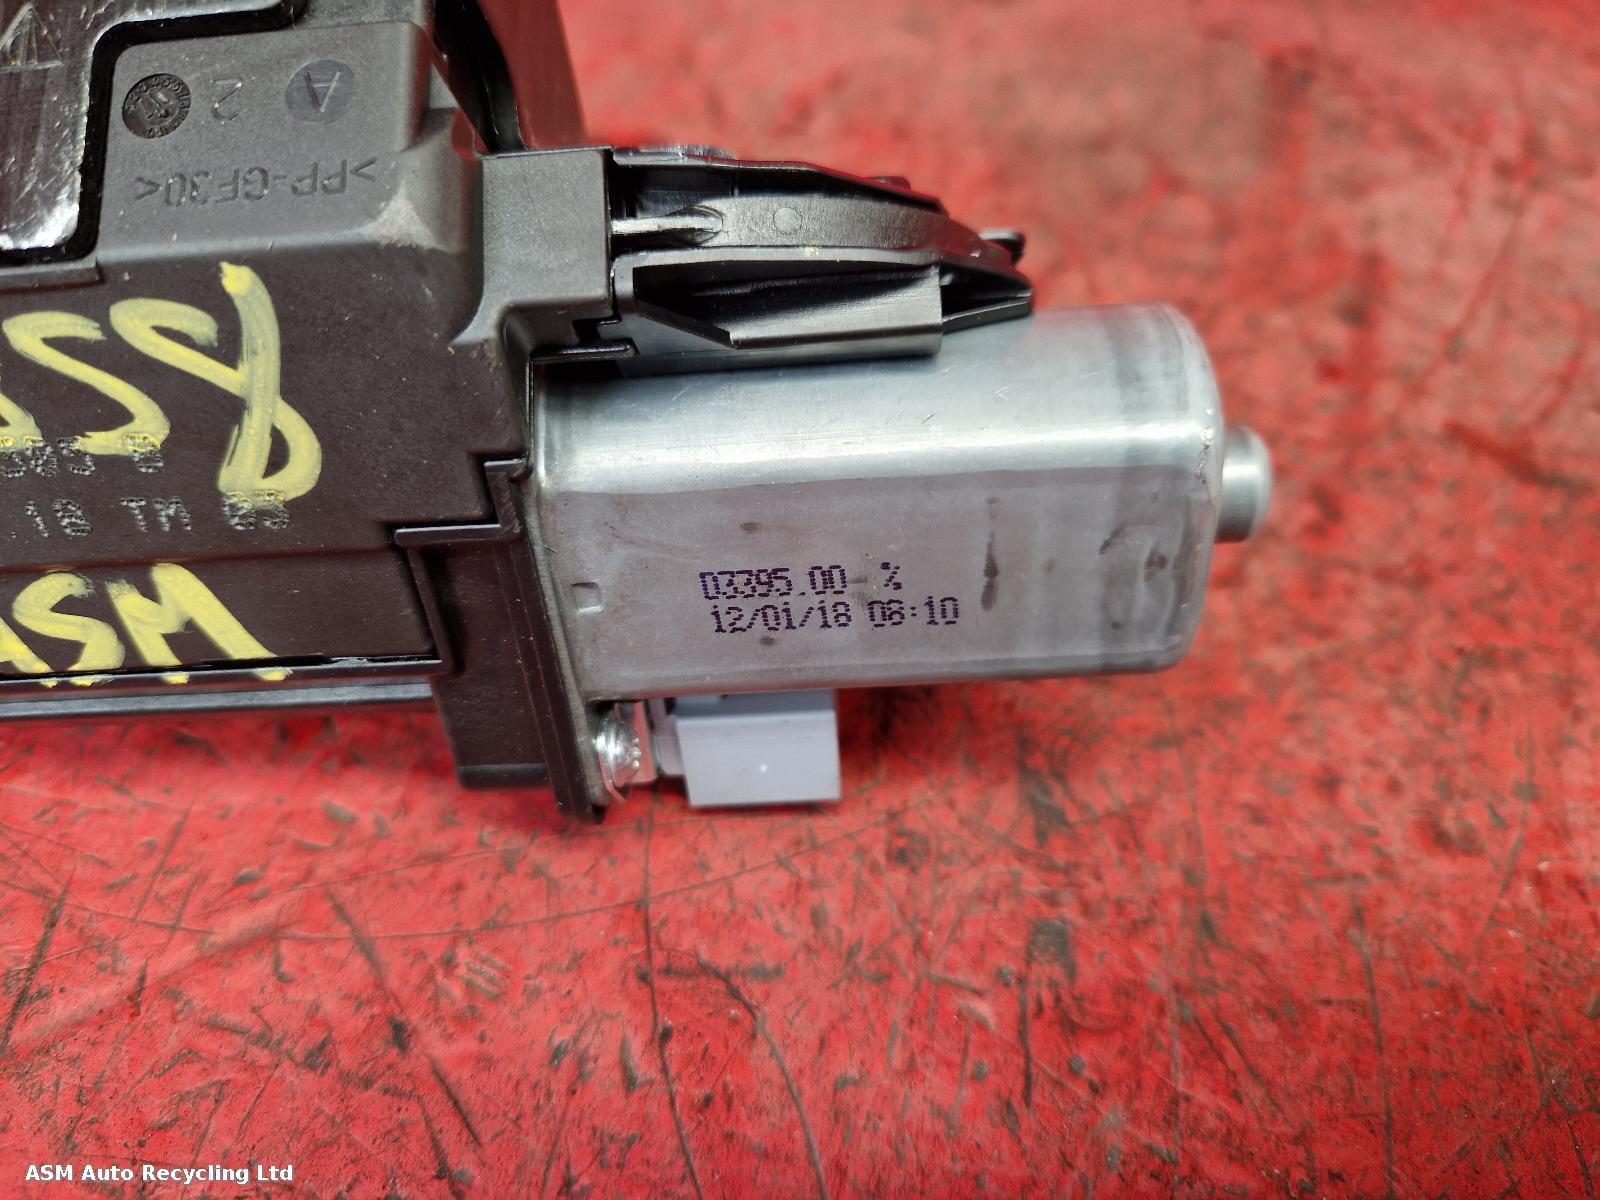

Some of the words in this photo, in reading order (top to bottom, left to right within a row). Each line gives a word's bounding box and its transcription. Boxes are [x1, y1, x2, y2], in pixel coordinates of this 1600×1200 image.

[209, 75, 245, 122] 2
[303, 68, 345, 115] A
[699, 564, 848, 600] 03395.00
[711, 599, 852, 634] 12/01/18
